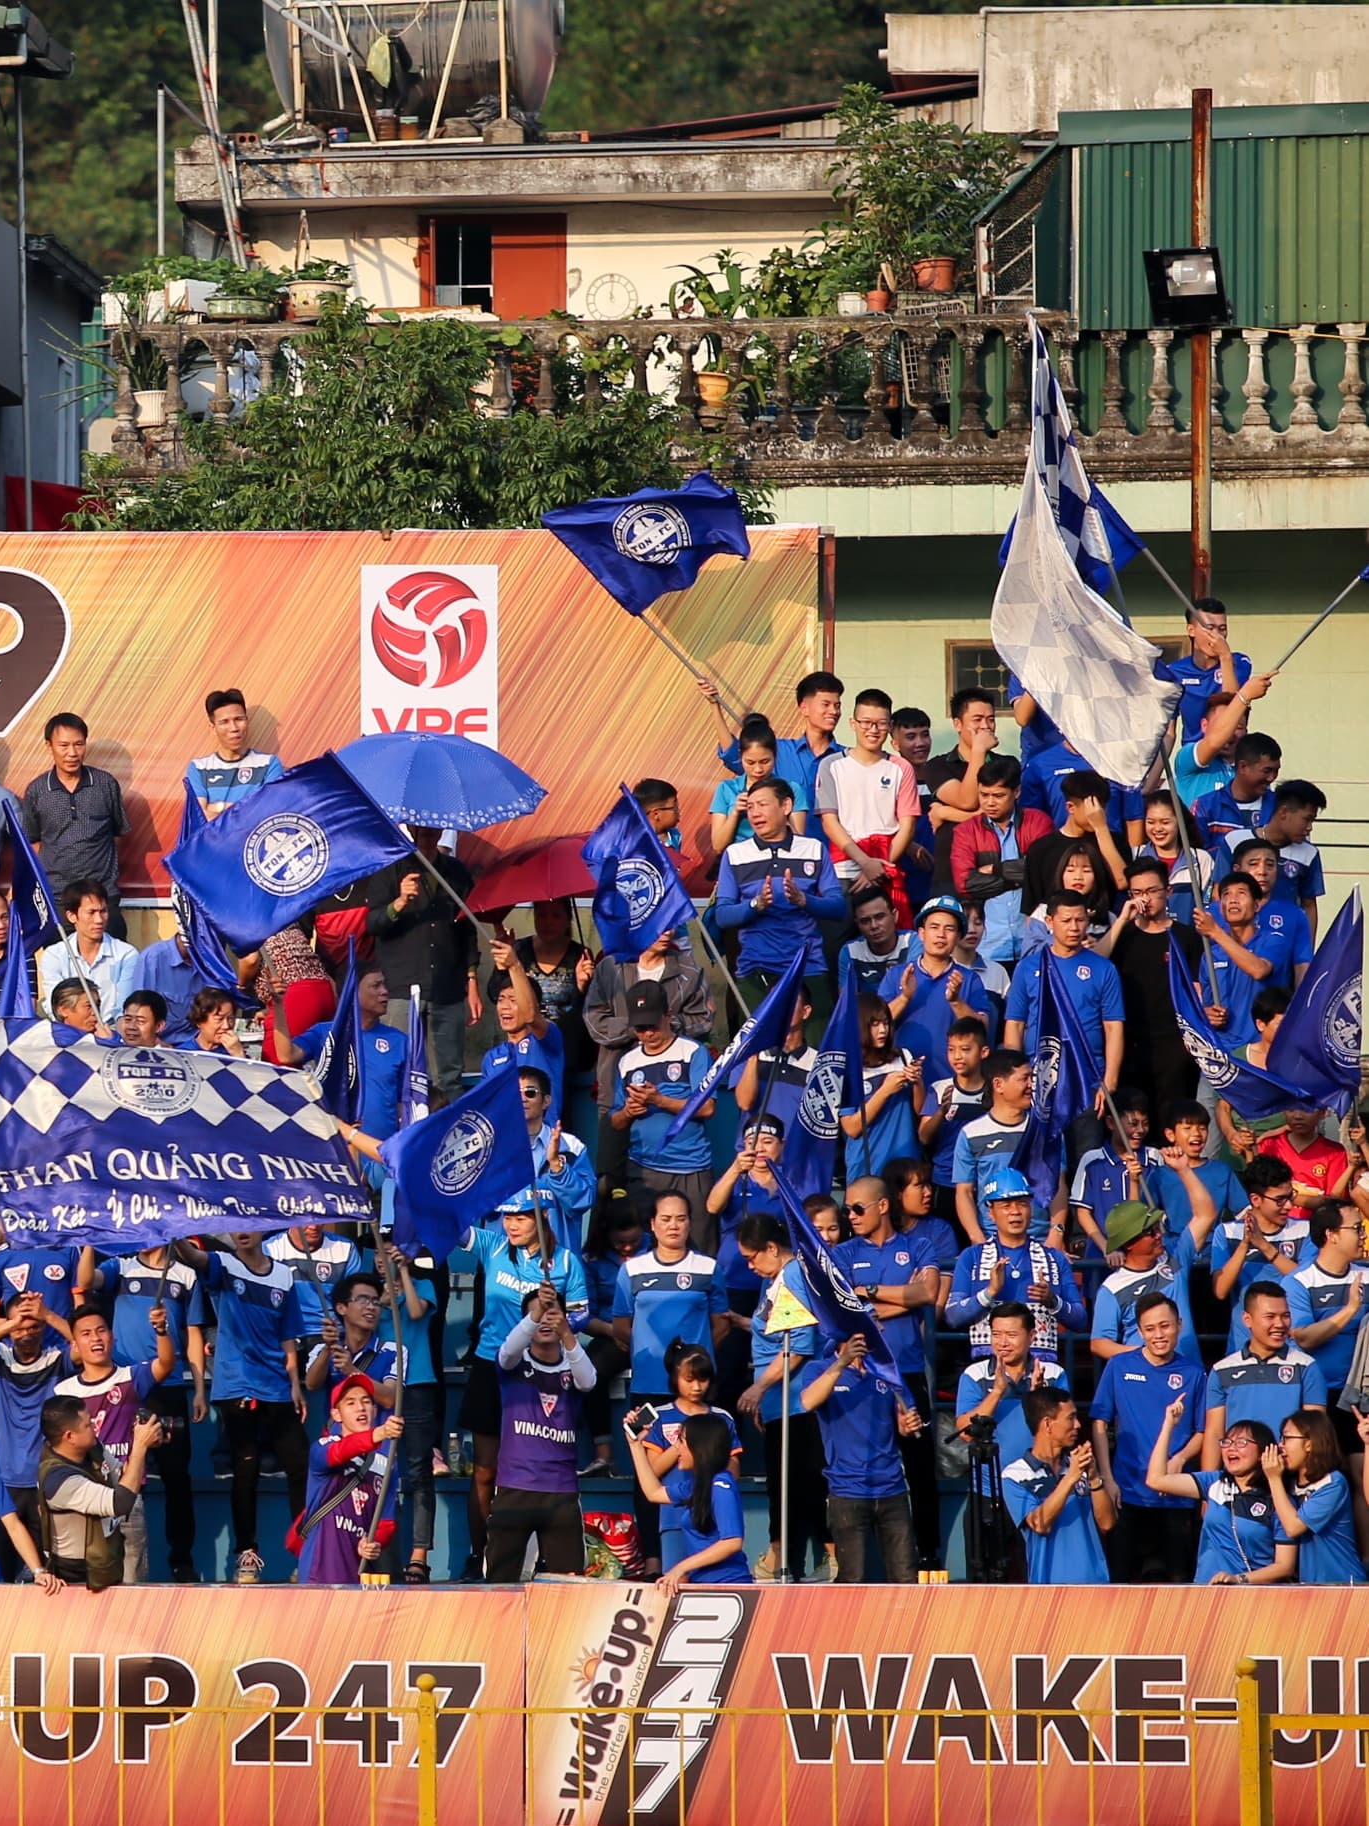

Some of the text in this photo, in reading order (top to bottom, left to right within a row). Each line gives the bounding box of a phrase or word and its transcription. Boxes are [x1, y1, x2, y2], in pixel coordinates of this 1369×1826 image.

[120, 1066, 151, 1077] TQN
[164, 1067, 184, 1078] FC
[106, 1143, 254, 1181] QUẢNG
[258, 1154, 359, 1187] NINH
[2, 1207, 50, 1233] Đoàn
[52, 1203, 87, 1230] Kết
[514, 1420, 576, 1443] VINACOMIN
[229, 1657, 486, 1768] 247
[771, 1652, 1369, 1770] WAKE-U
